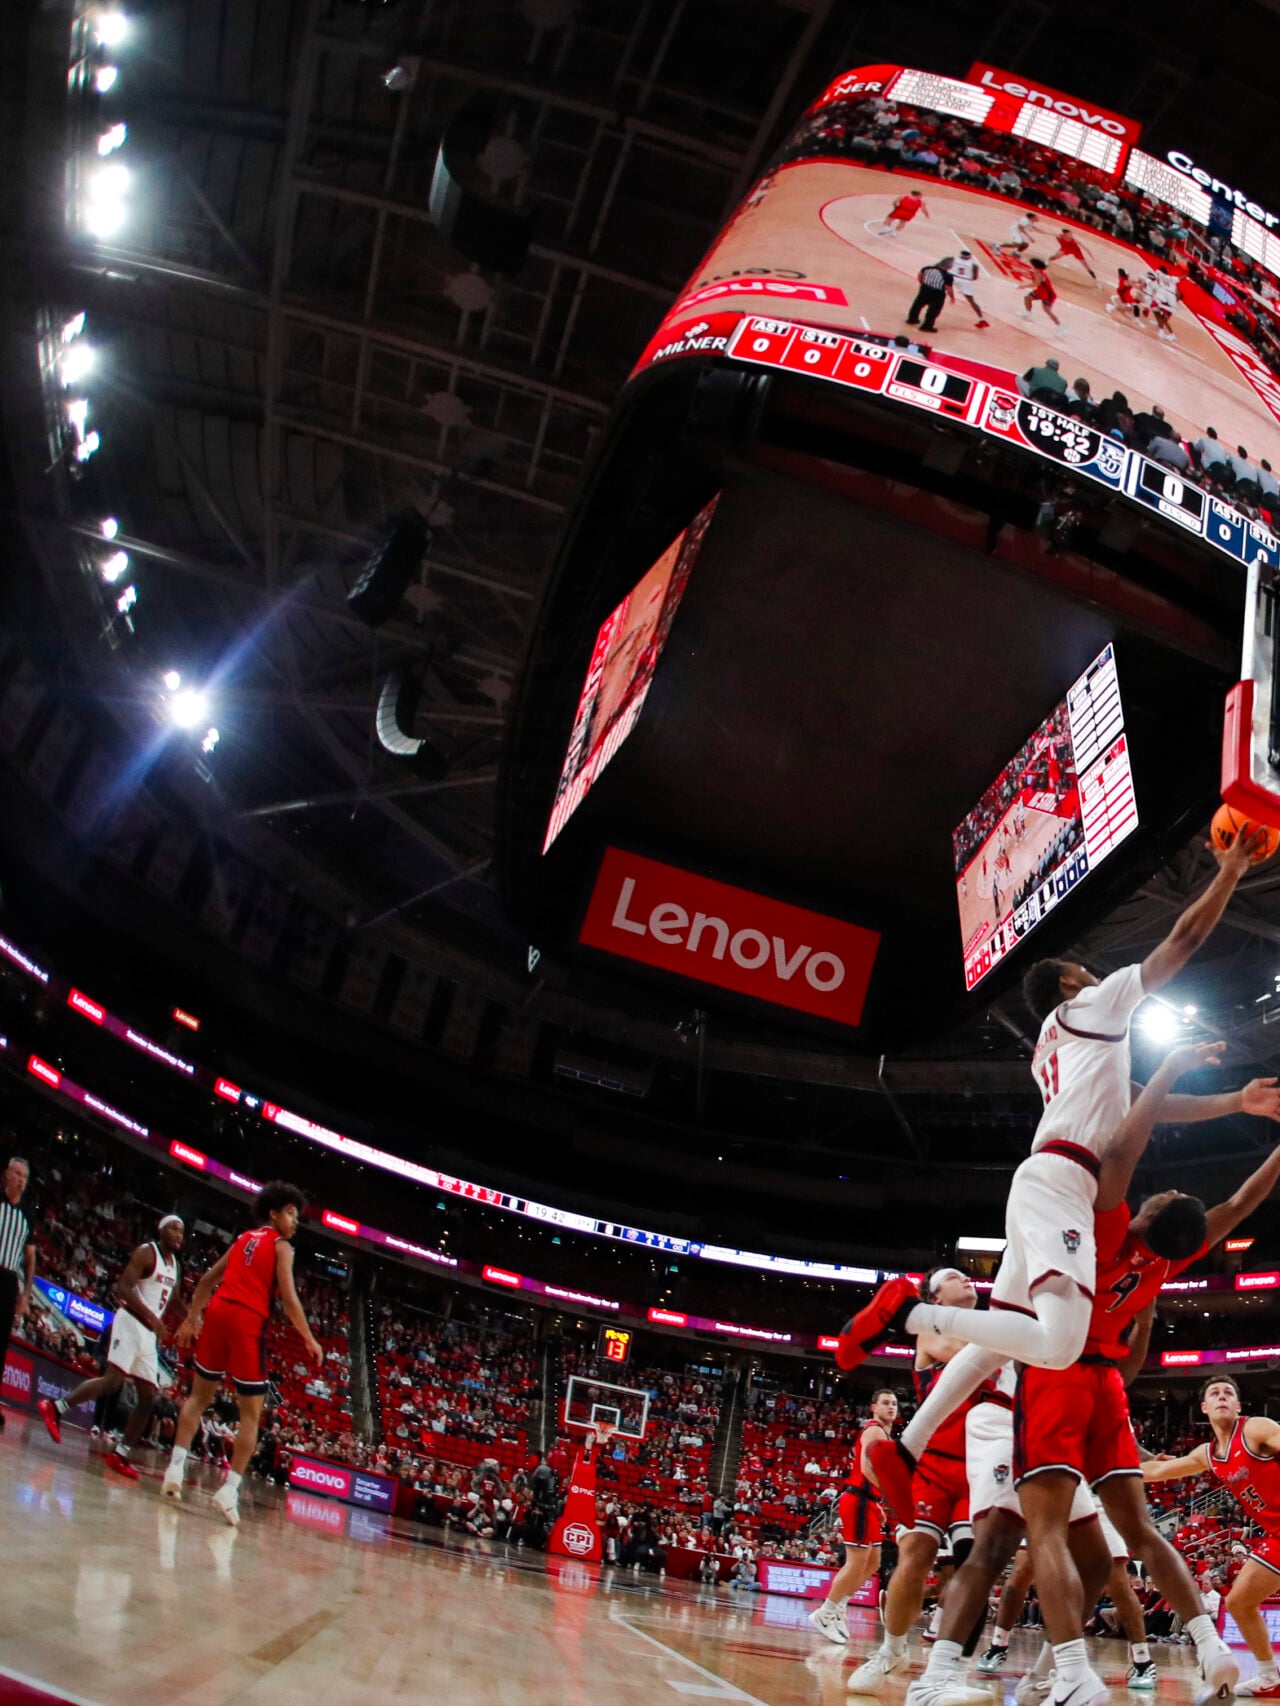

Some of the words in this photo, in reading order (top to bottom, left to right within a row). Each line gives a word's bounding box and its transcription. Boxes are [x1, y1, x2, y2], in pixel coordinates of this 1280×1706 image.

[980, 71, 1126, 135] Lenovo
[1167, 151, 1280, 228] Center
[653, 336, 727, 361] MILNER
[754, 320, 788, 335] AST
[804, 330, 836, 347] STL
[859, 343, 884, 359] TO
[753, 338, 770, 352] 0
[804, 349, 821, 364] 0
[854, 363, 871, 377] 0
[920, 368, 947, 395] 0
[1031, 405, 1055, 423] 1ST
[1056, 417, 1090, 437] HALF
[1027, 415, 1091, 456] 19:42
[1162, 475, 1184, 505] 0
[1215, 502, 1240, 526] AST
[1251, 524, 1276, 551] STL
[1218, 524, 1232, 541] 0
[612, 877, 845, 992] Lenovo
[72, 993, 103, 1019] Lenovo
[32, 1060, 59, 1083] Lenovo
[174, 1144, 204, 1165] Lenovo
[326, 1213, 357, 1232] Lenovo
[243, 1237, 260, 1266] 4
[486, 1268, 519, 1284] Lenovo
[1188, 1280, 1200, 1288] for
[1198, 1280, 1208, 1288] all
[1239, 1276, 1276, 1287] Lenovo
[158, 1289, 169, 1311] 5
[1105, 1271, 1141, 1313] 9
[70, 1299, 105, 1321] Advanced
[652, 1310, 685, 1324] Lenovo
[607, 1340, 626, 1361] 13
[1164, 1354, 1199, 1363] Lenovo
[1226, 1350, 1250, 1359] Smarter
[354, 1484, 390, 1500] technology
[579, 1487, 596, 1497] PNC
[566, 1532, 591, 1546] CPI
